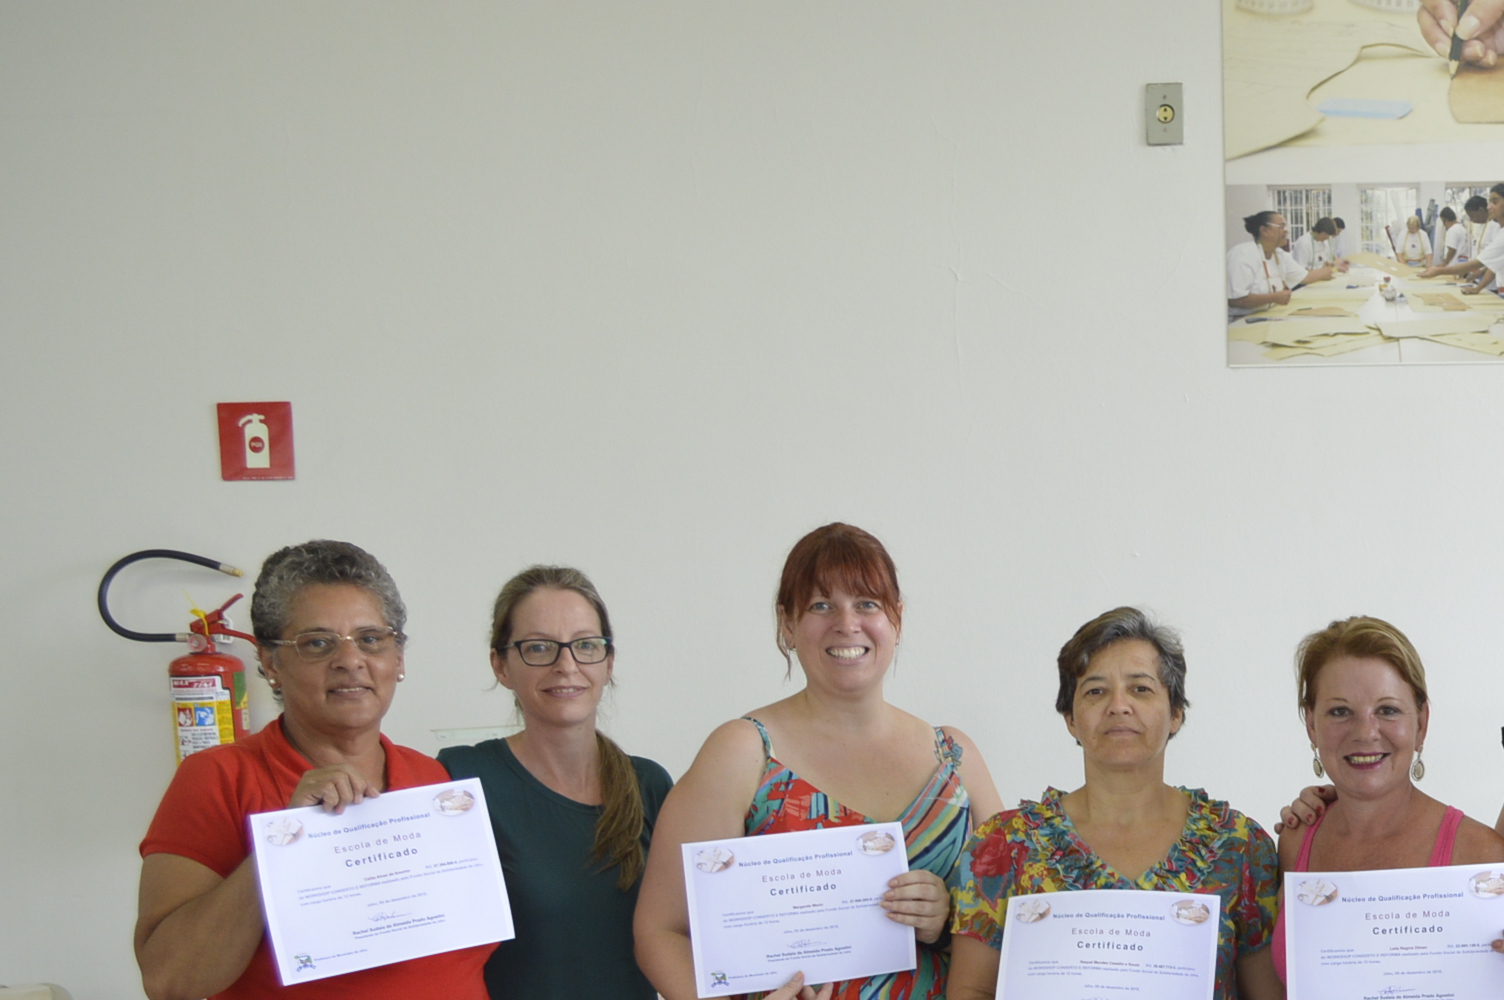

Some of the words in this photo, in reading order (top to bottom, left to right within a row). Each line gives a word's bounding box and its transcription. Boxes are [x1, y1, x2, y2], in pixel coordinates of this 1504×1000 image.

[308, 829, 331, 839] Núcleo
[343, 819, 388, 833] Qualificação
[389, 812, 431, 824] Profissional
[334, 841, 370, 854] Escola
[376, 838, 388, 846] de
[393, 831, 421, 842] Moda
[345, 847, 418, 868] Certificado
[739, 860, 761, 868] Núcleo
[773, 854, 813, 864] Qualificação
[815, 851, 853, 859] Profissional
[762, 873, 795, 883] Escola
[816, 868, 842, 877] Moda
[770, 883, 837, 896] Certificado
[1378, 894, 1421, 902] Qualificação
[1423, 892, 1464, 900] Profissional
[1126, 913, 1165, 921] Profissional
[1365, 911, 1400, 920] Escola
[1406, 911, 1418, 919] de
[1423, 910, 1450, 918] Moda
[1109, 928, 1120, 936] de
[1125, 929, 1151, 937] Moda
[1372, 924, 1443, 935] Certificado
[1077, 941, 1144, 951] Certificado
